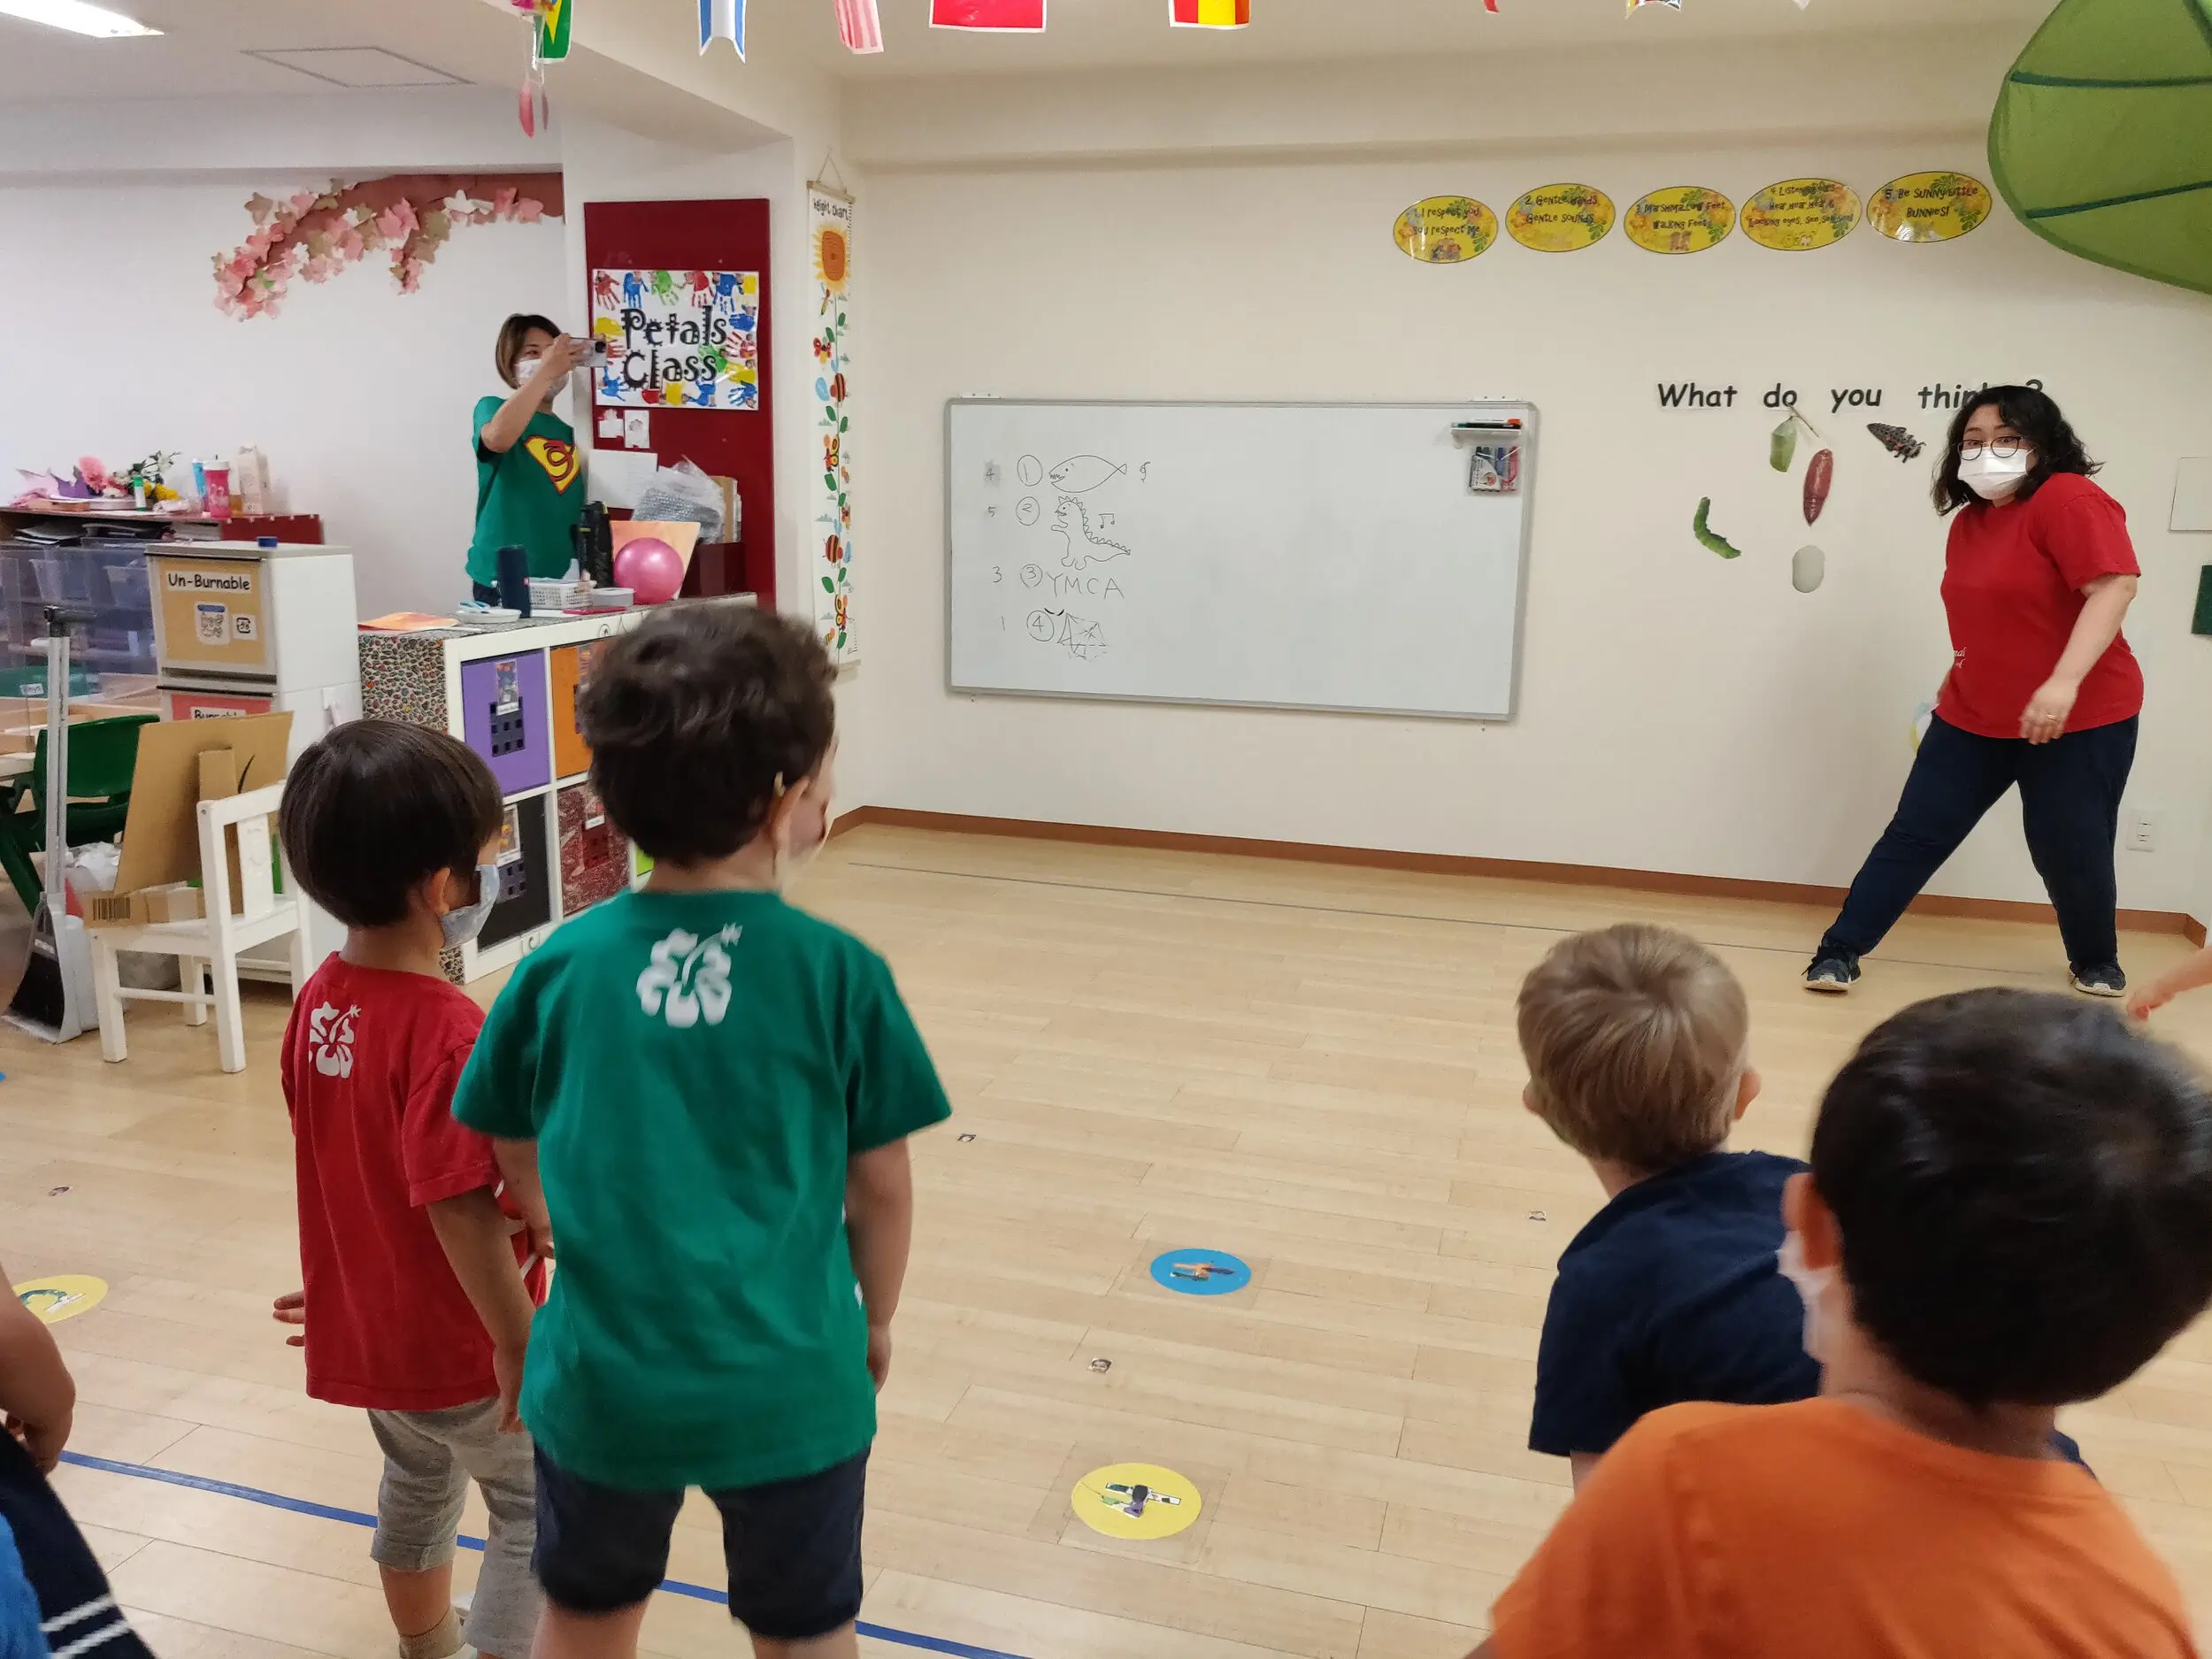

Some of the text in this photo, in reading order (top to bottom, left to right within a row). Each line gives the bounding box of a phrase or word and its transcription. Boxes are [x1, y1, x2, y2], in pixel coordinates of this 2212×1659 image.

[1431, 225, 1465, 236] respect
[620, 304, 727, 350] Petals
[620, 349, 718, 392] Class
[1657, 381, 1738, 408] What
[1763, 382, 1798, 408] do
[1831, 388, 1882, 414] you
[1917, 382, 1988, 410] thin
[987, 505, 996, 518] 5
[167, 572, 250, 590] Un-Burnable
[992, 565, 1002, 583] 3
[1045, 571, 1125, 600] YMCA
